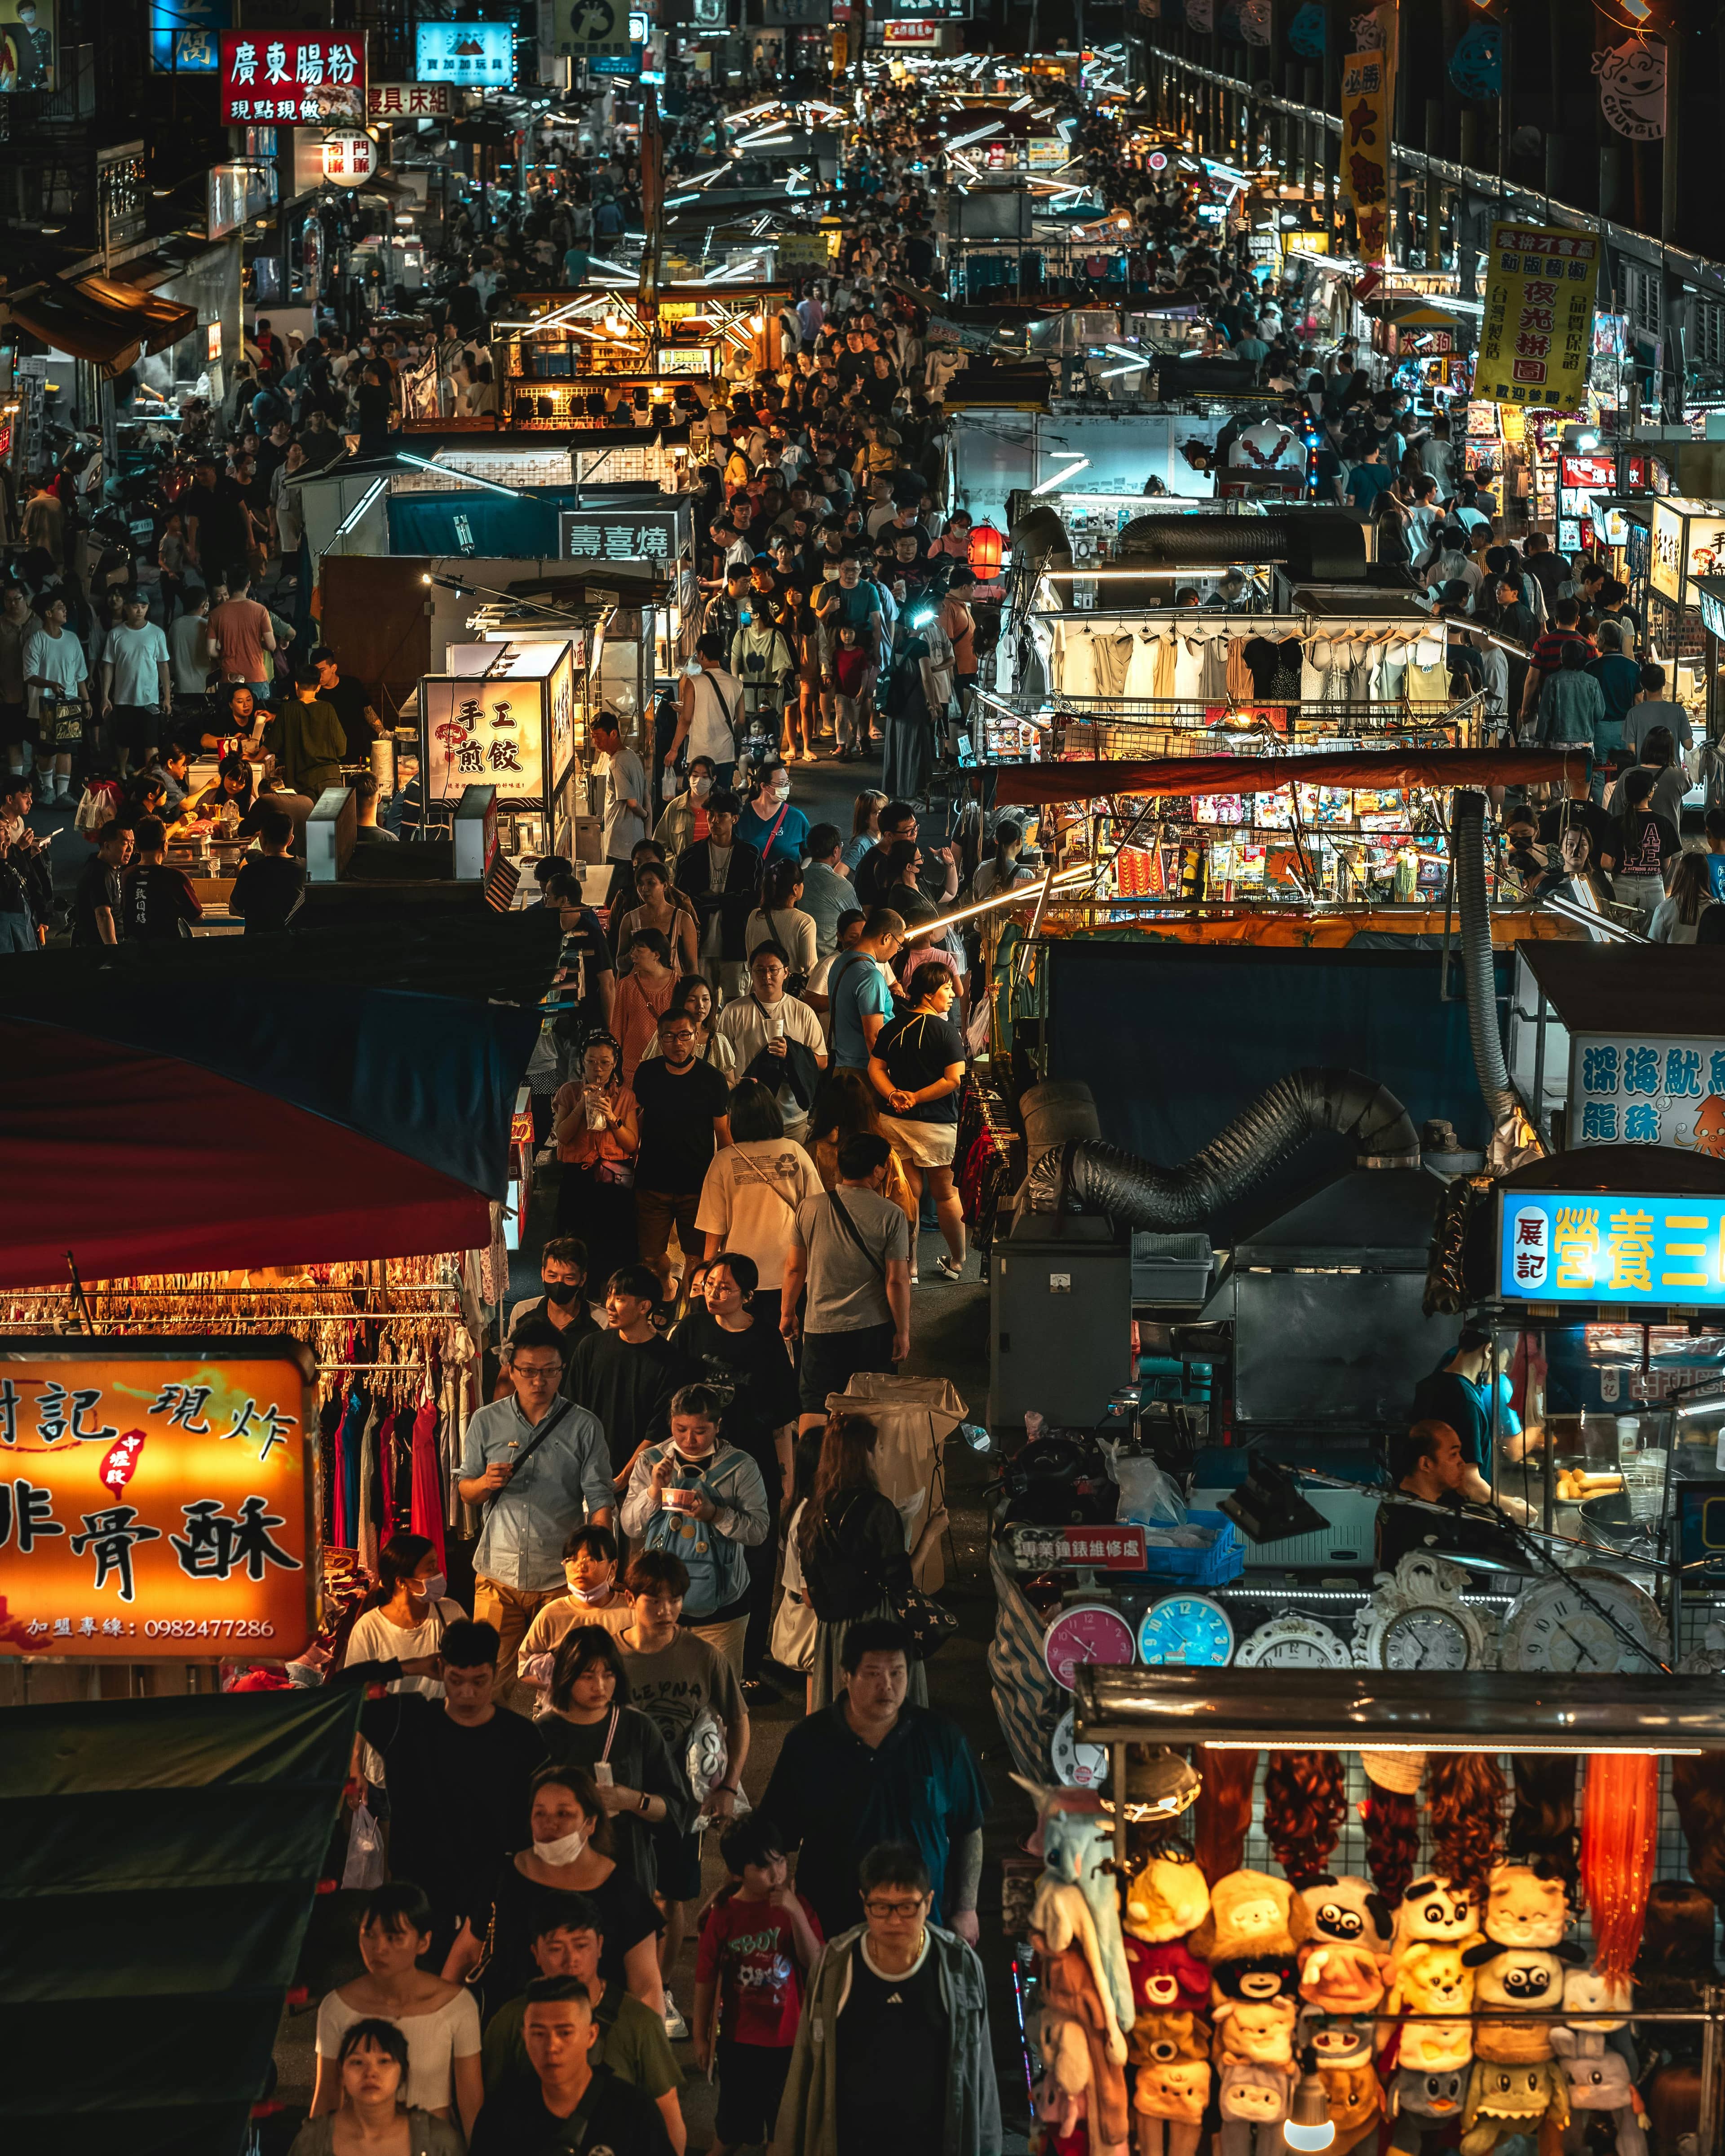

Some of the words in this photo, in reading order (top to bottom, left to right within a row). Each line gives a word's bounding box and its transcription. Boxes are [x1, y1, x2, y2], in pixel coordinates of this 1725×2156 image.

[231, 41, 358, 86] 廣東腸粉
[231, 100, 322, 120] 現點現做
[1603, 95, 1661, 138] CHUNGLI
[1485, 285, 1508, 360] 台灣製造
[1562, 295, 1587, 371] 品質保證
[570, 525, 668, 557] 壽喜燒
[455, 698, 517, 733] 手工
[453, 739, 524, 774] 煎餃
[1582, 1100, 1662, 1144] 龍珠
[1517, 1218, 1545, 1279] 展記
[1554, 1207, 1725, 1291] 營養三
[148, 1383, 300, 1462] 現炸
[1084, 1614, 1093, 1623] 12
[1179, 1602, 1191, 1614] 12
[1210, 1619, 1222, 1629] 2
[145, 1618, 274, 1638] 0982477286
[1115, 1628, 1121, 1637] 2
[1215, 1636, 1228, 1645] 3
